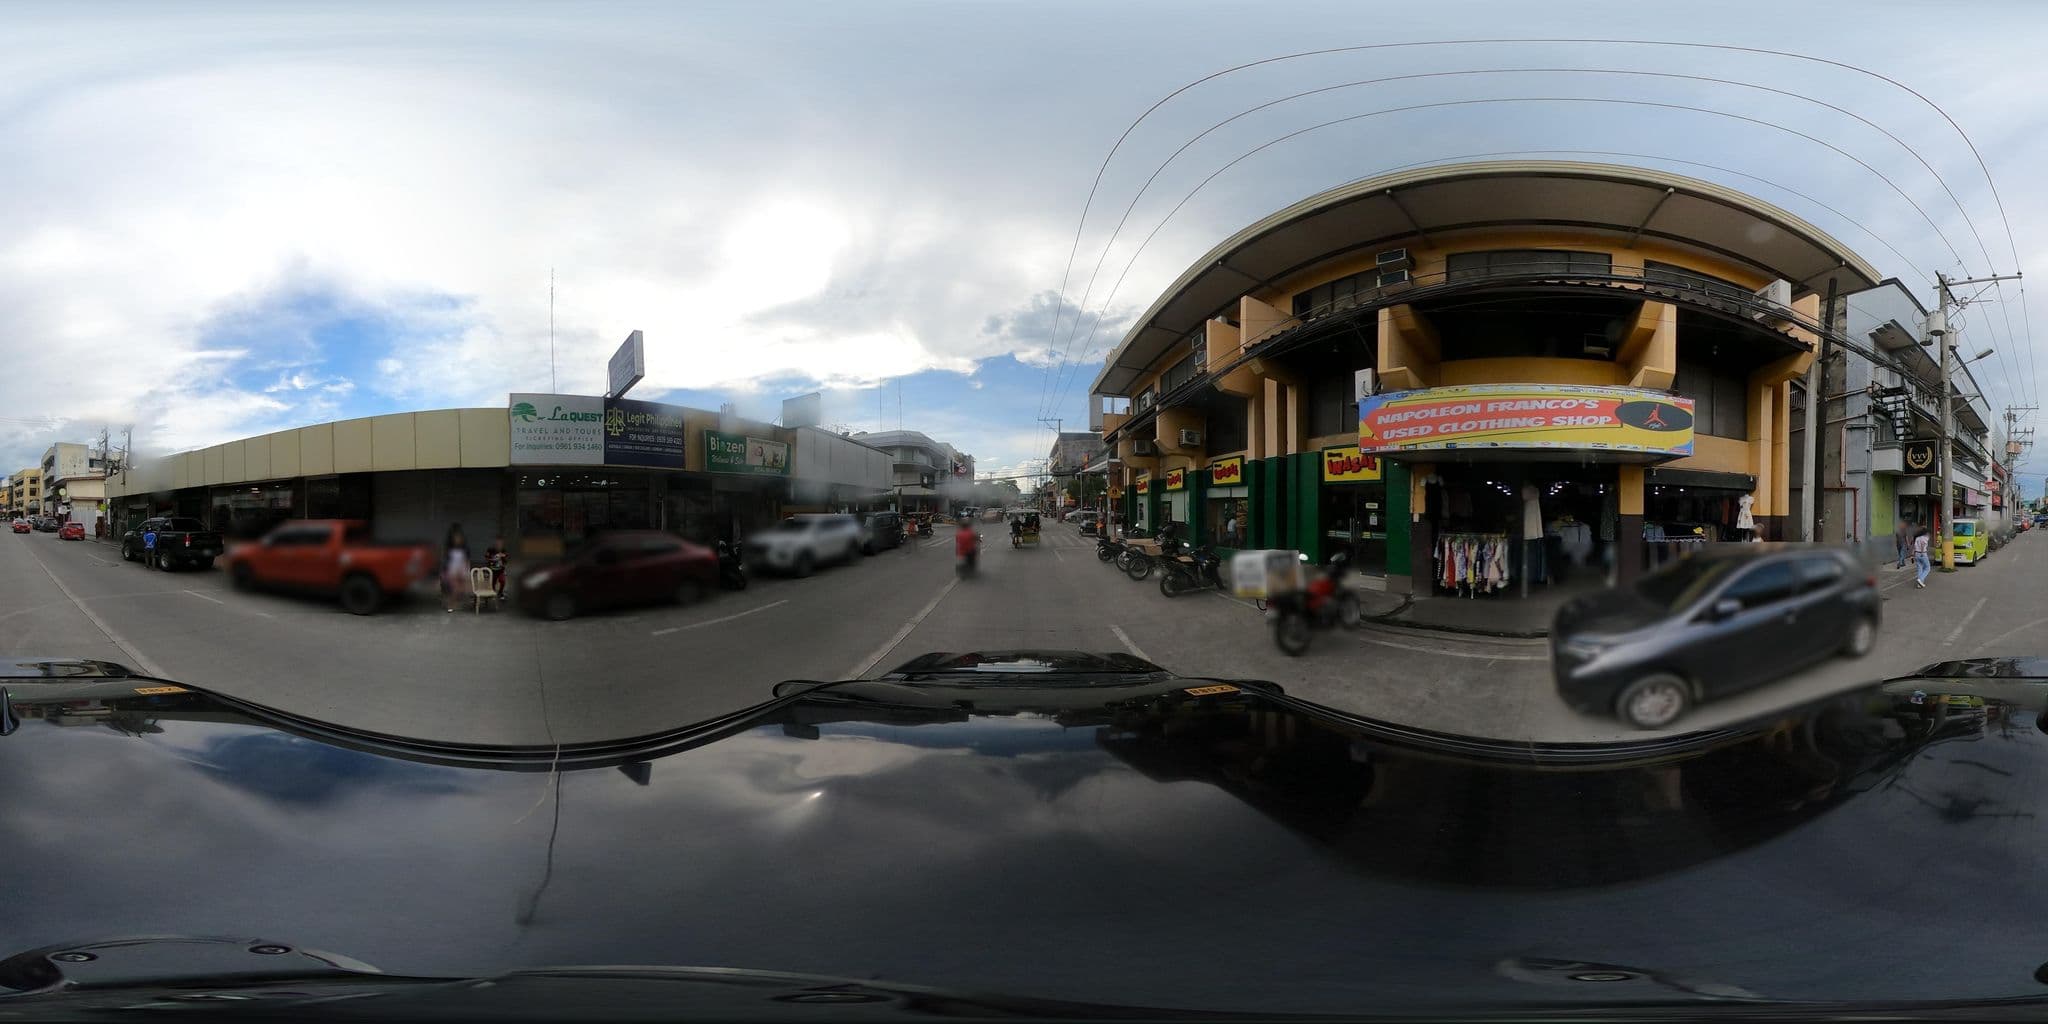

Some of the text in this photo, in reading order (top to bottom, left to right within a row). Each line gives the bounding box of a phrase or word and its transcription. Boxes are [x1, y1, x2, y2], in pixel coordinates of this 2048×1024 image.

[627, 411, 645, 426] Legit
[1377, 399, 1600, 425] NAPOLEON FRANCO'S
[1383, 415, 1613, 440] USED CLOTHING SHOP
